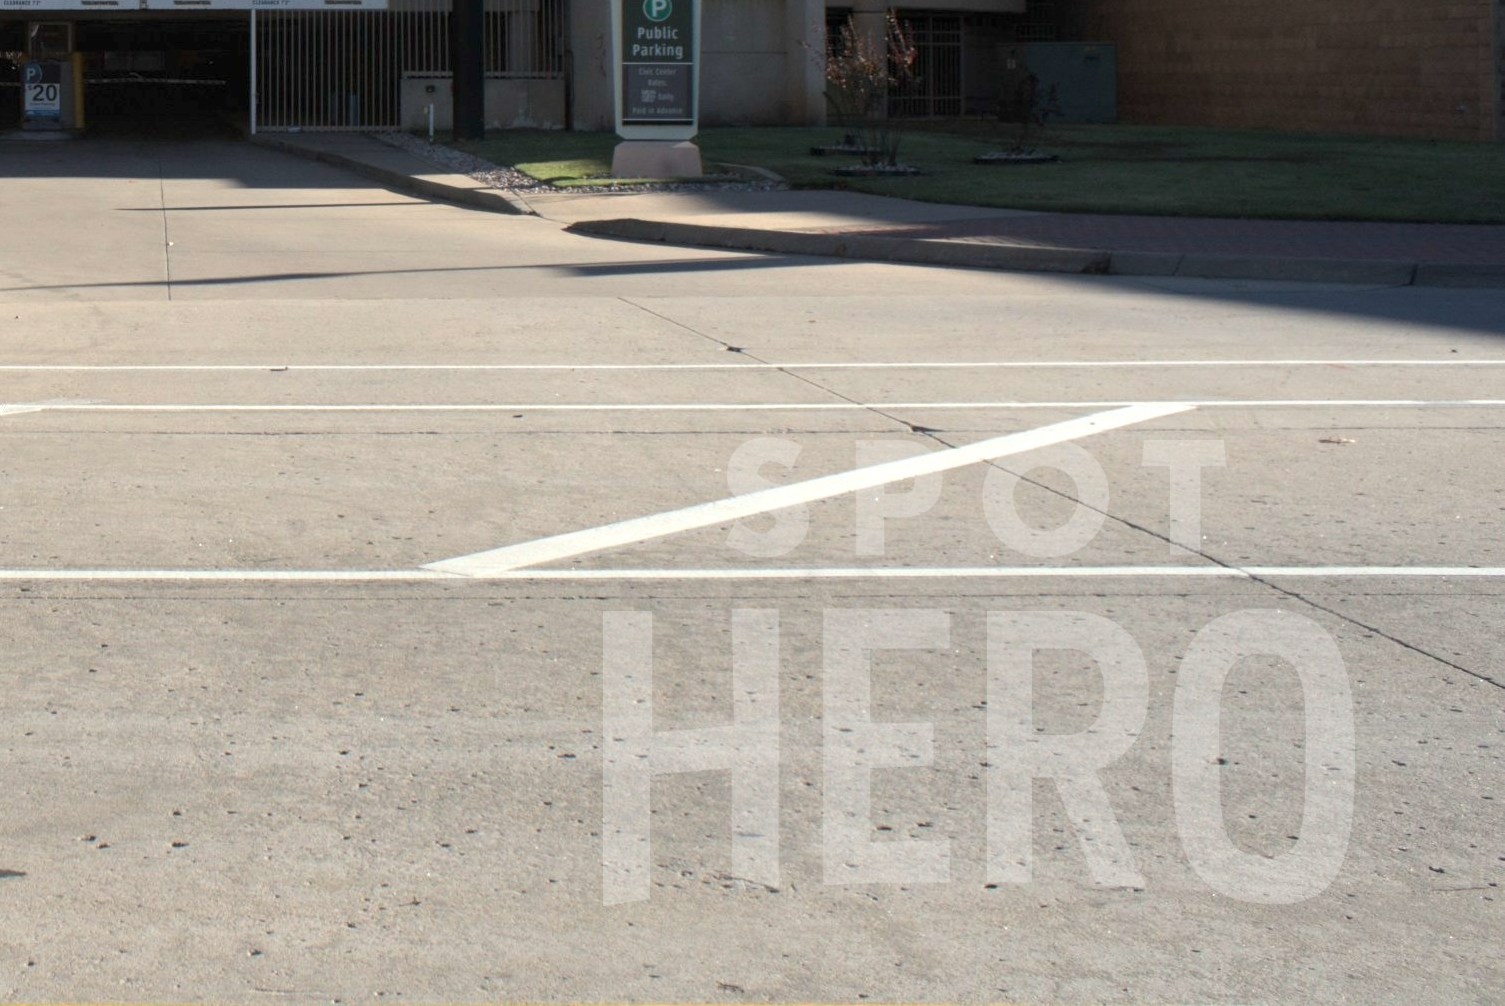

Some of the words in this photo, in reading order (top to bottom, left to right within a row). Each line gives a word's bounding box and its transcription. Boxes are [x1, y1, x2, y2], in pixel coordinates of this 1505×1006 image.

[637, 26, 679, 40] Public
[632, 43, 683, 60] Parking
[26, 67, 36, 81] P
[655, 67, 677, 76] Center
